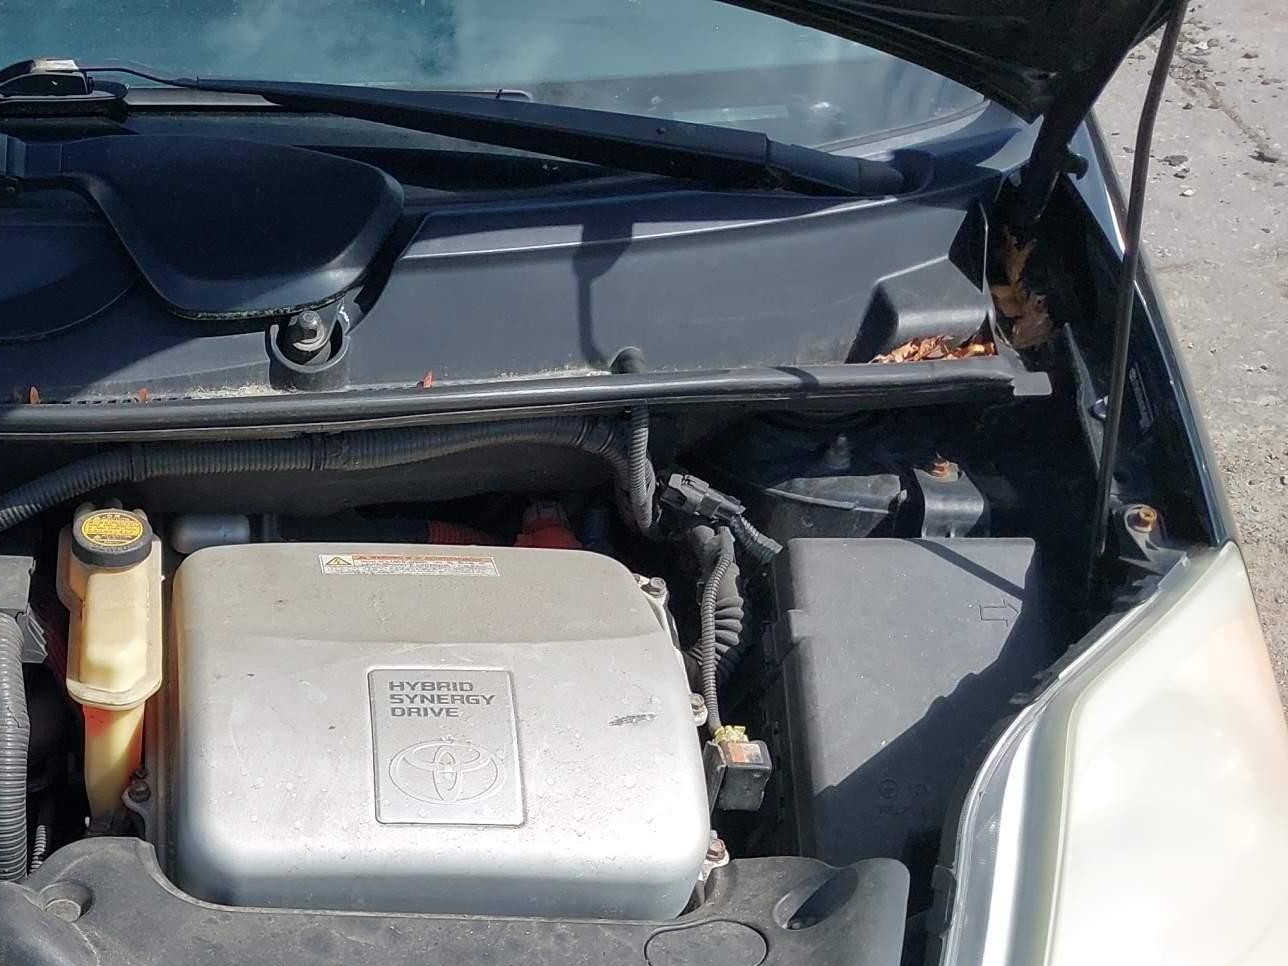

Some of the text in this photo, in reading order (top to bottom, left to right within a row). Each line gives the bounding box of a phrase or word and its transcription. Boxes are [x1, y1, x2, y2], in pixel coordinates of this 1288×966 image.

[388, 681, 474, 692] HYBRID
[389, 694, 496, 705] SYNERGY
[390, 707, 460, 717] DRIVE
